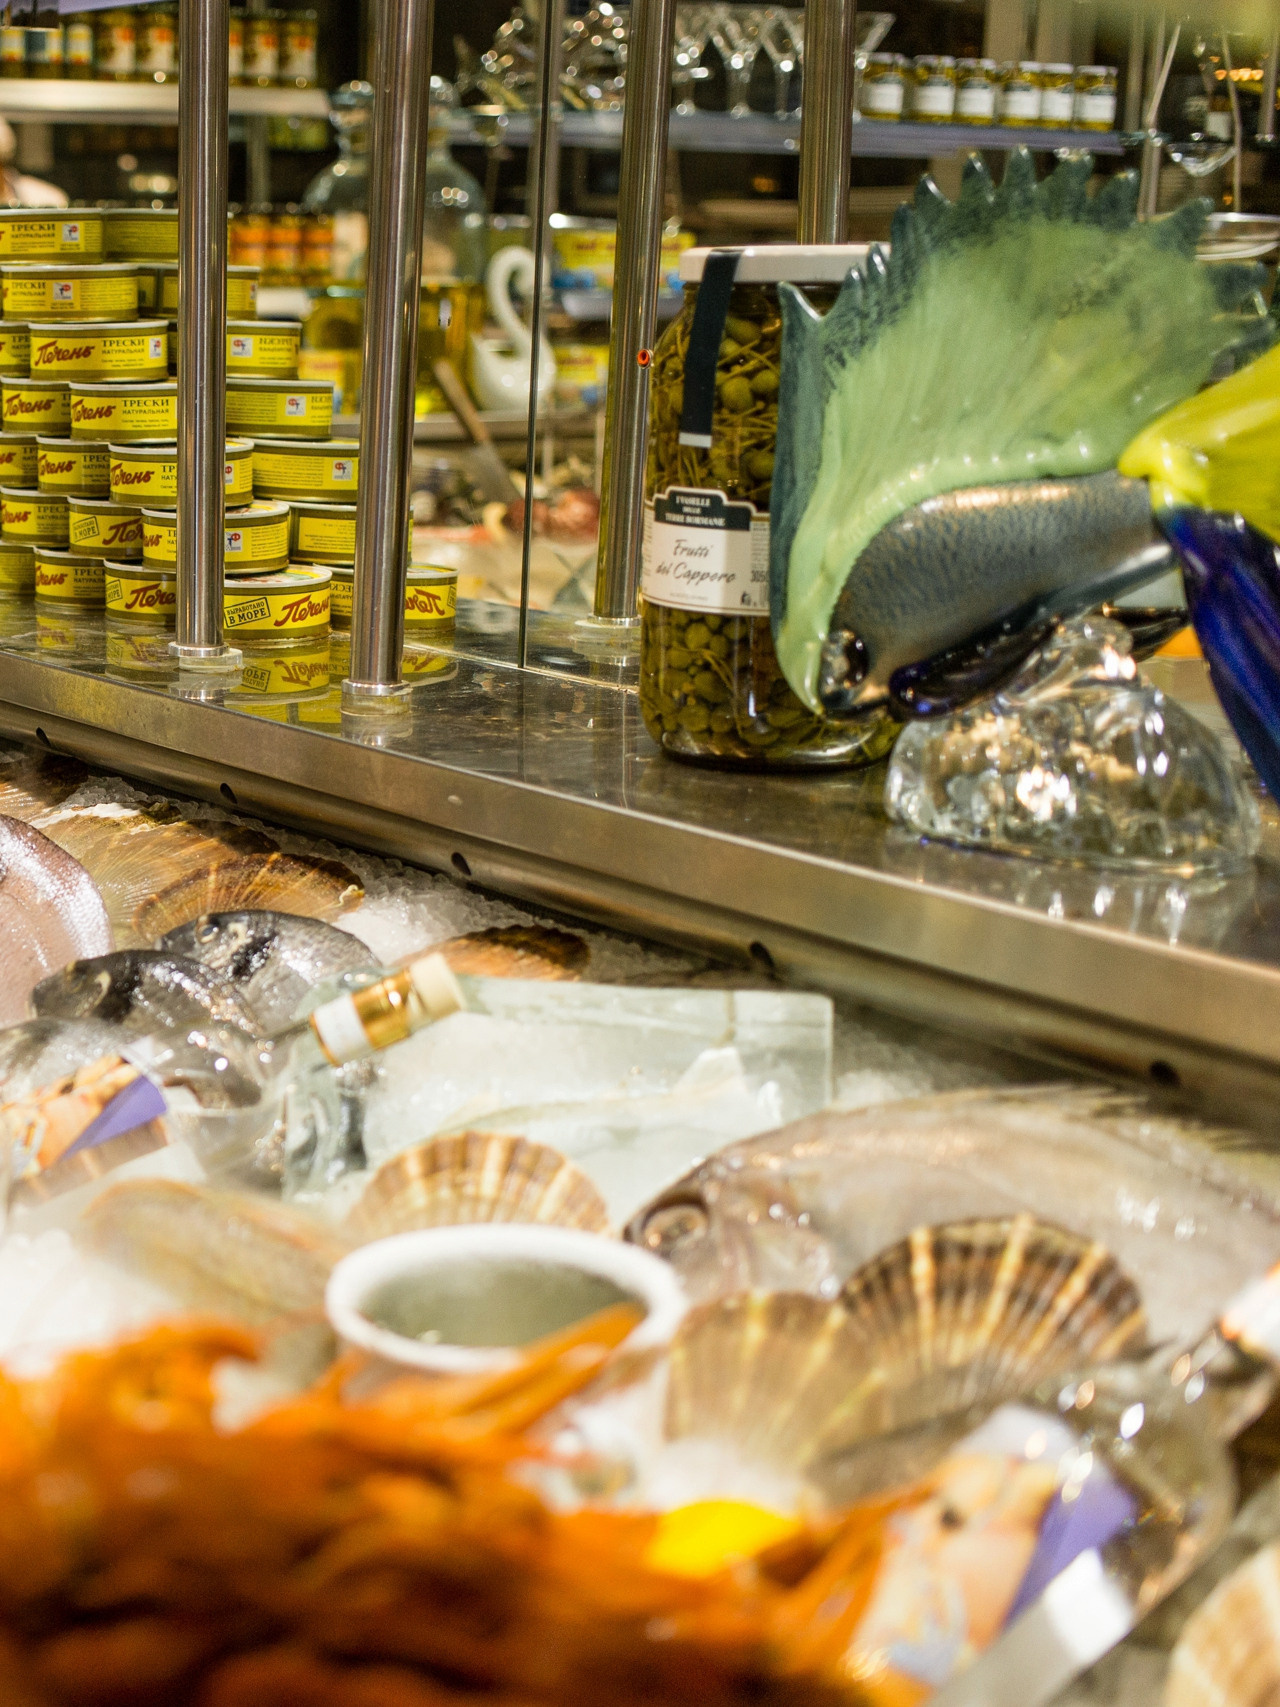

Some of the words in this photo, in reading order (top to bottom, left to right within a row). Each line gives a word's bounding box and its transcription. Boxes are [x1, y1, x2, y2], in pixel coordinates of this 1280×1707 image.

[11, 223, 56, 232] ТРЕСКИ
[101, 339, 145, 347] ТРЕСКИ
[35, 340, 96, 366] Печень
[101, 347, 145, 355] НАТУРАЛЬНАЯ
[4, 393, 56, 418] Печень
[121, 399, 169, 407] ТРЕСКИ
[122, 407, 170, 415] НАТУРАЛЬНАЯ
[673, 539, 714, 558] Frutti
[673, 561, 737, 586] Cappero
[226, 601, 266, 616] ВЫРАБОТАНО
[229, 615, 237, 626] В
[237, 607, 267, 623] МОРЕ
